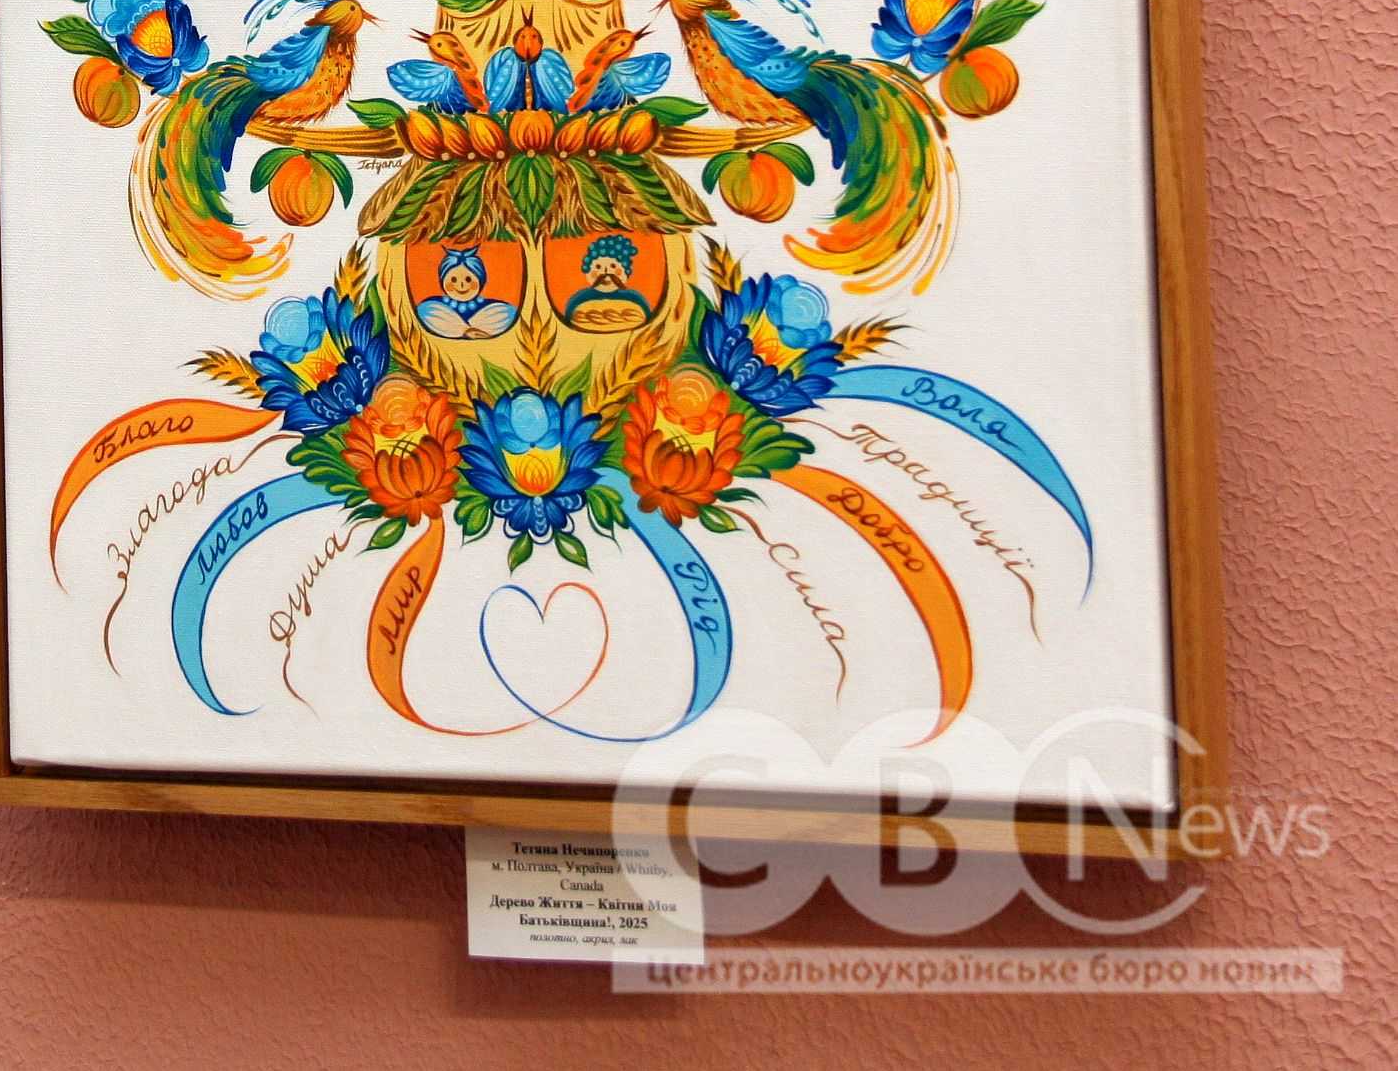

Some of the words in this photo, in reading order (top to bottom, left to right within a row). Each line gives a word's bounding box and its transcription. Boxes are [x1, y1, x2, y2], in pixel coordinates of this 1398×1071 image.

[92, 412, 196, 465] Благо
[902, 376, 1026, 453] Воля
[106, 451, 244, 580] Злагода
[194, 490, 269, 586] Любов
[826, 486, 926, 574] Добро
[852, 423, 1035, 577] Традиції
[268, 532, 354, 645] Душа
[385, 562, 423, 656] Мир
[672, 560, 720, 656] Рід
[768, 542, 847, 646] Сила
[491, 861, 504, 871] м.
[507, 860, 562, 874] Полтава,
[565, 861, 614, 877] Україна
[626, 863, 673, 879] Whitby,
[512, 841, 558, 856] Тетяна
[562, 843, 650, 860] Нечипоренко
[559, 879, 605, 893] Canada
[490, 894, 535, 911] Дерево
[538, 895, 584, 910] Життя
[598, 897, 644, 911] Квітни
[647, 899, 677, 912] Моя
[519, 913, 616, 930] Батьківщина!,
[619, 916, 649, 930] 2025
[619, 936, 639, 946] лак
